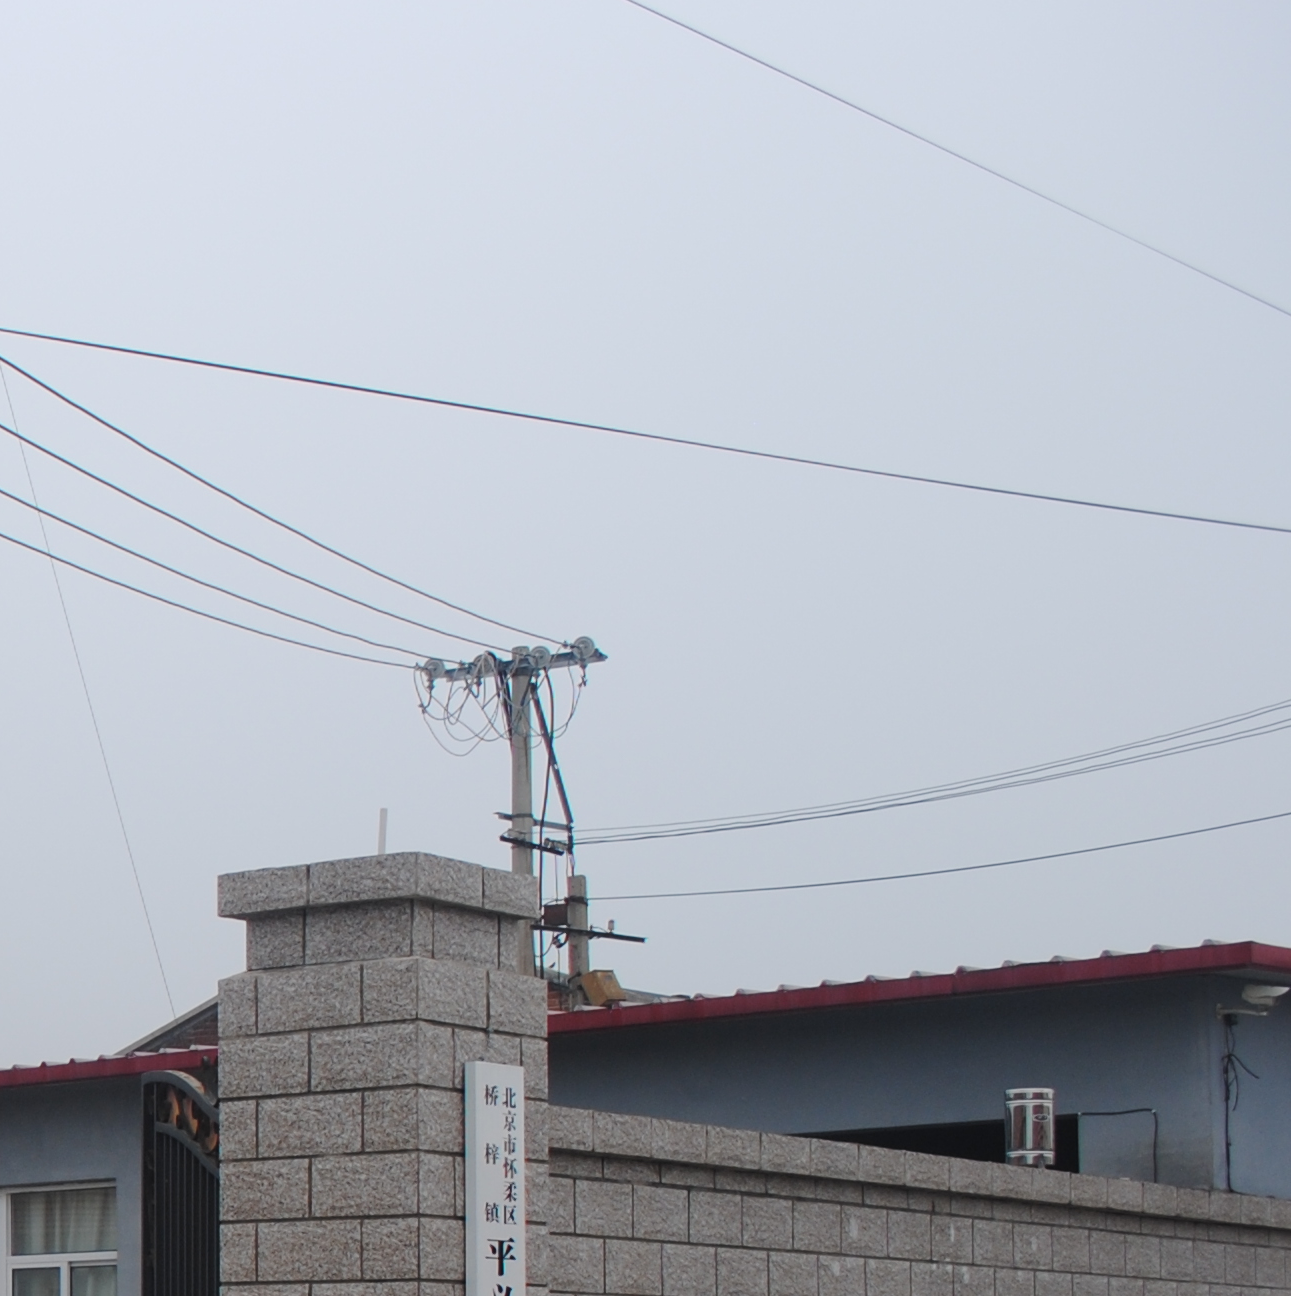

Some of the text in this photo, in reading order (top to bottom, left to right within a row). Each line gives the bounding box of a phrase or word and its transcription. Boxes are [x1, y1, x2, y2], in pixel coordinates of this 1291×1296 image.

[483, 1084, 500, 1224] 桥梓镇
[501, 1086, 518, 1226] 北京市怀柔区
